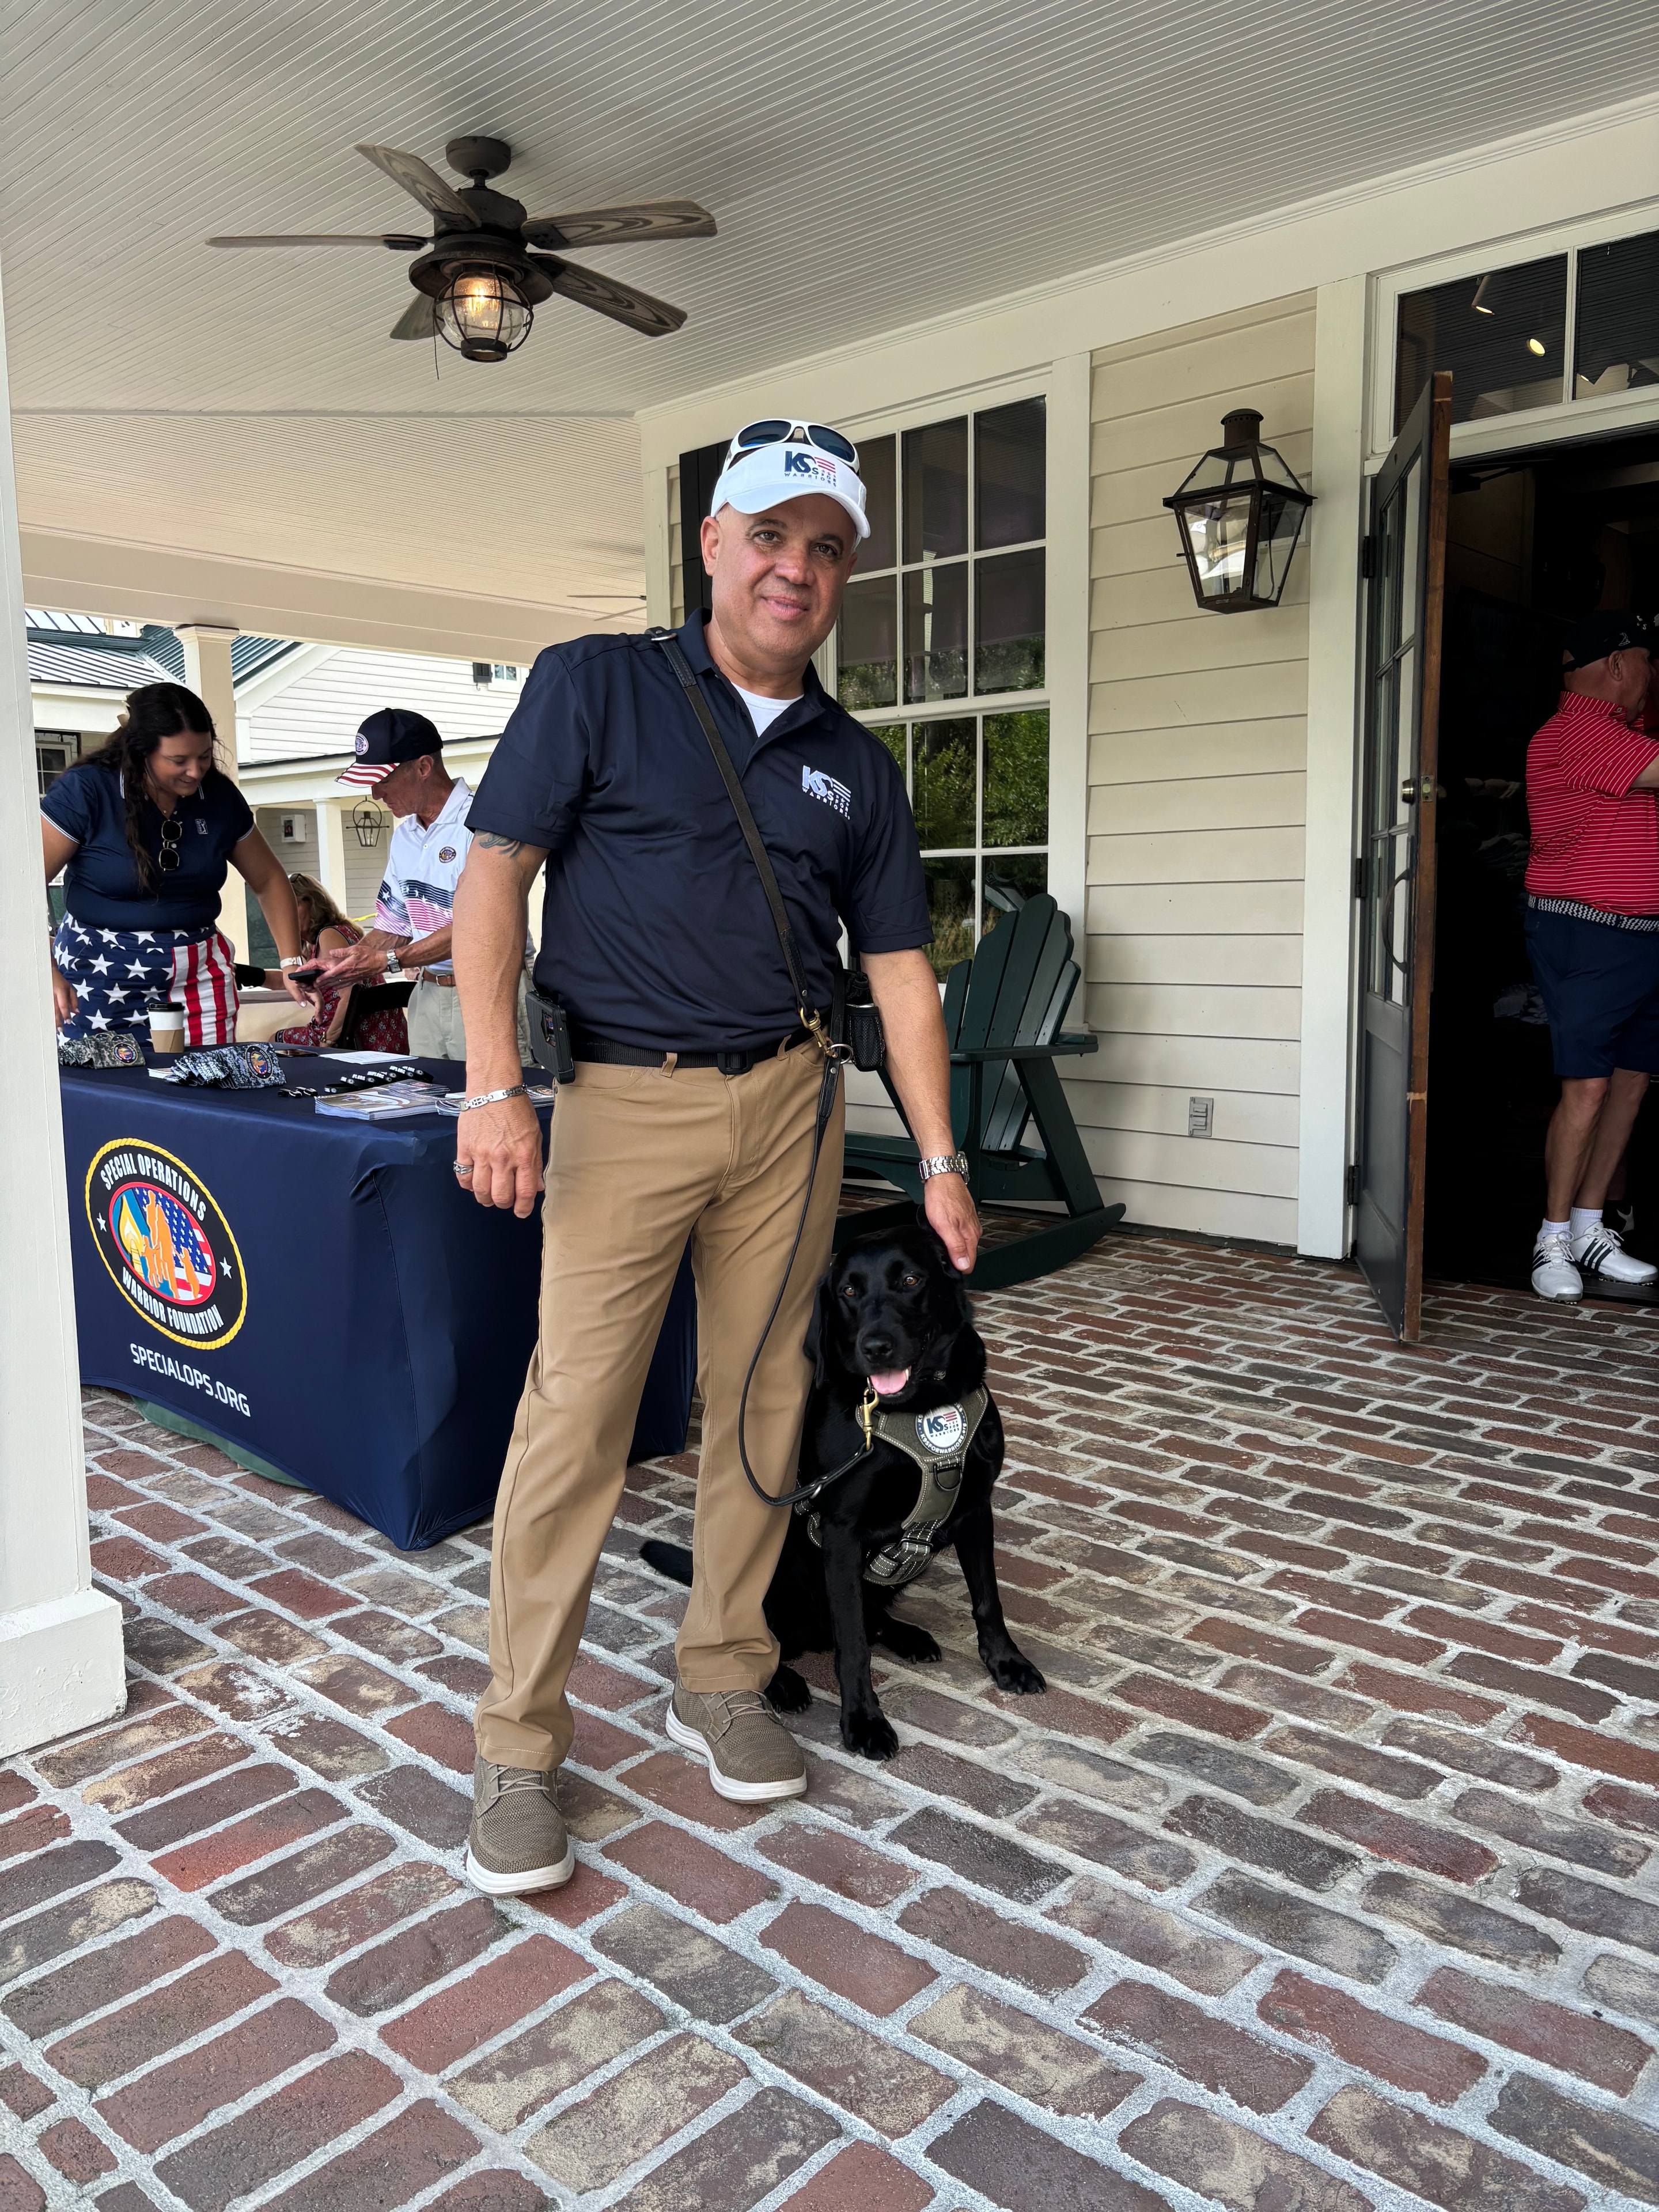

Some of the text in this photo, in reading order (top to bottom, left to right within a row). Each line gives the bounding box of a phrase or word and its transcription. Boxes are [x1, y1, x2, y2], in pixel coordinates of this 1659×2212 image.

[784, 472, 837, 487] WARRIORS
[802, 787, 848, 818] WARRIORS
[100, 1153, 207, 1221] SPECIAL OPERATIONS
[123, 1266, 225, 1335] WARRIOR FOUNDATION
[130, 1343, 251, 1418] SPECIALOPS.ORG
